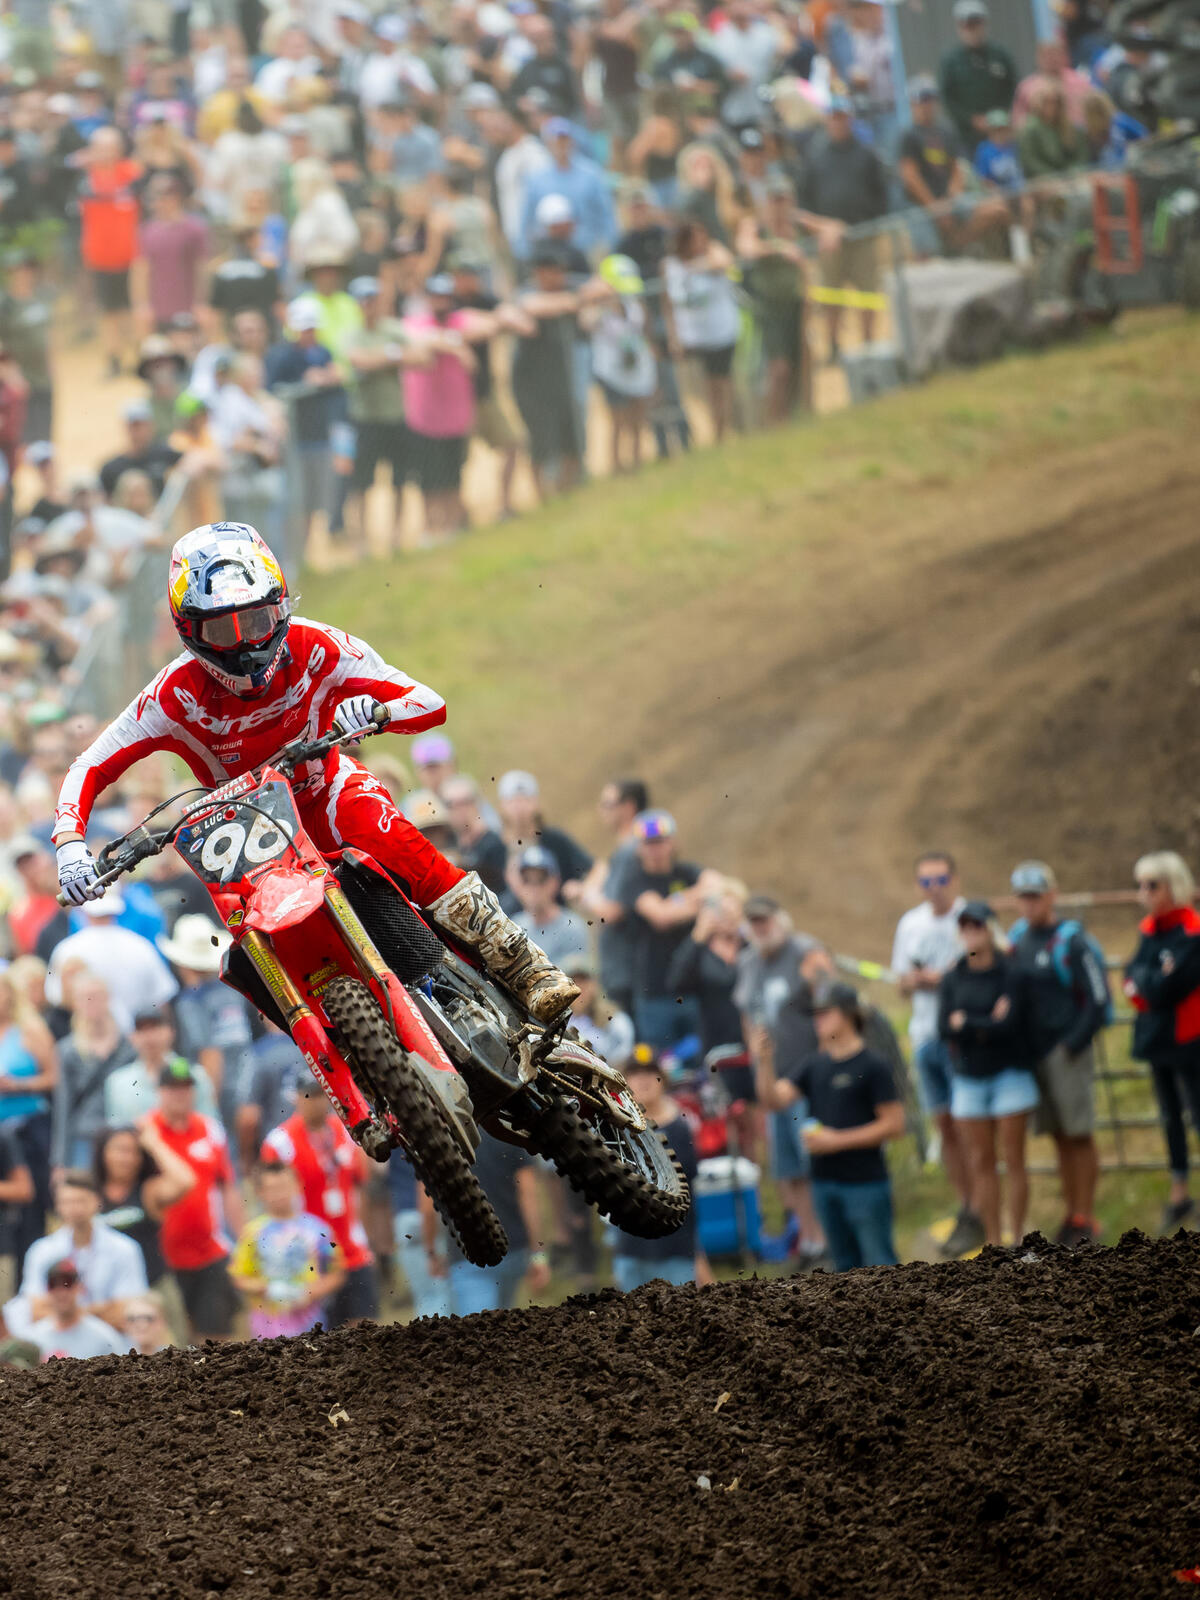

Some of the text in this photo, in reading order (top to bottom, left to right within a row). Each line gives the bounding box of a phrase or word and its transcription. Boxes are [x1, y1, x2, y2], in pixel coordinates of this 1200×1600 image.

[173, 643, 326, 736] alpinestars
[201, 801, 294, 885] 96
[204, 804, 235, 829] LUC
